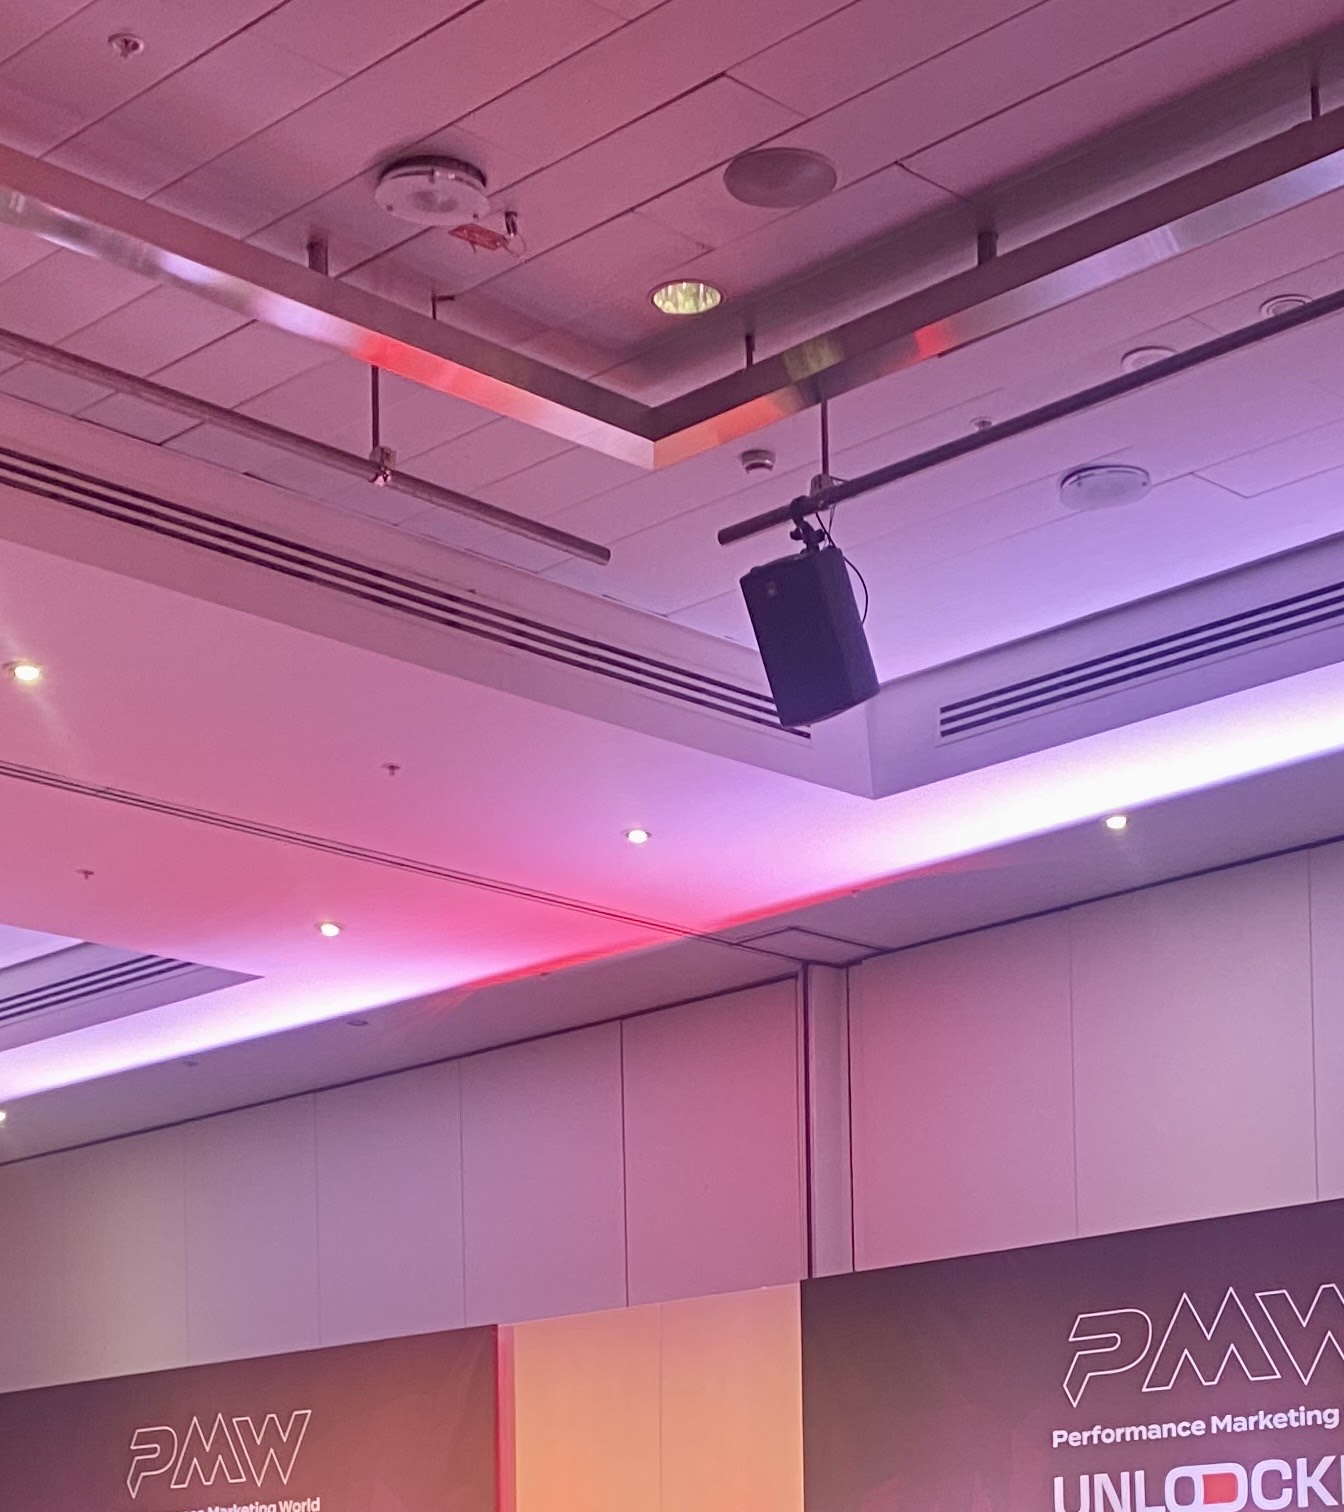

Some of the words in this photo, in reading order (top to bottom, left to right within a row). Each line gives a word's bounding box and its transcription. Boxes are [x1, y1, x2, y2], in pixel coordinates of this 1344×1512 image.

[127, 1409, 312, 1499] PMW
[1053, 1417, 1206, 1448] Performance
[1211, 1406, 1340, 1434] Marketing
